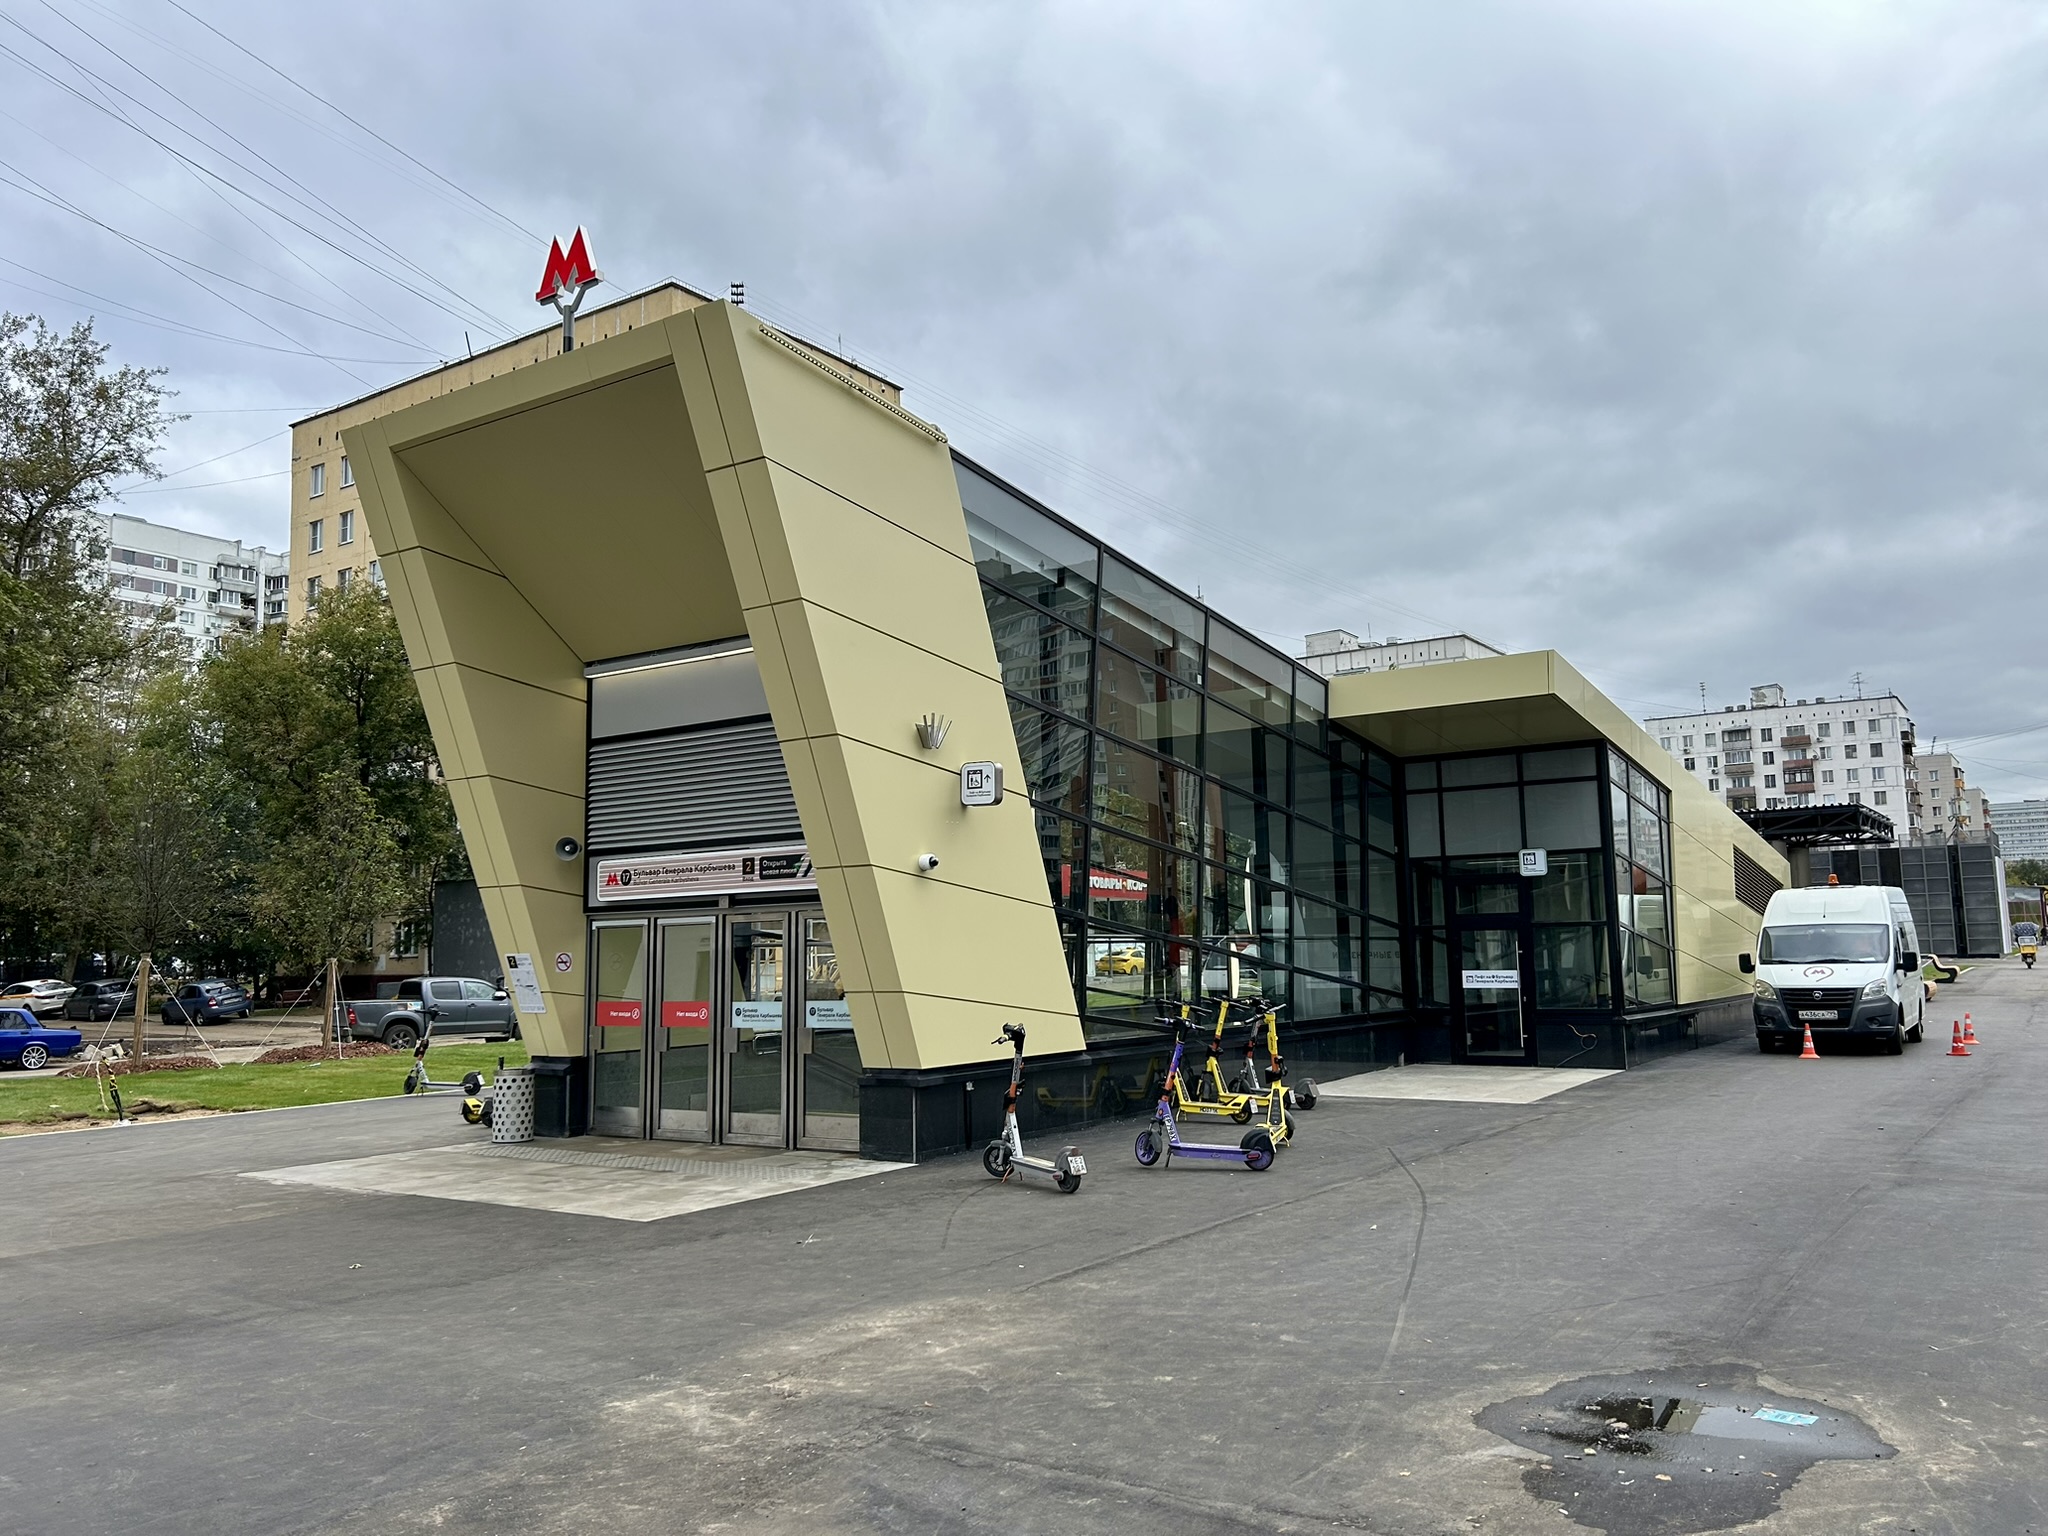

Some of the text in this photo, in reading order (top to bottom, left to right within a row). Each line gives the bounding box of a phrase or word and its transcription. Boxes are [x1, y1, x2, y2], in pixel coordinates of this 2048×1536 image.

[535, 224, 603, 302] М
[633, 869, 661, 878] Бульвар
[662, 867, 693, 875] Генерала
[694, 863, 736, 874] Карбышева
[745, 861, 752, 872] 2
[762, 860, 788, 868] Открыта
